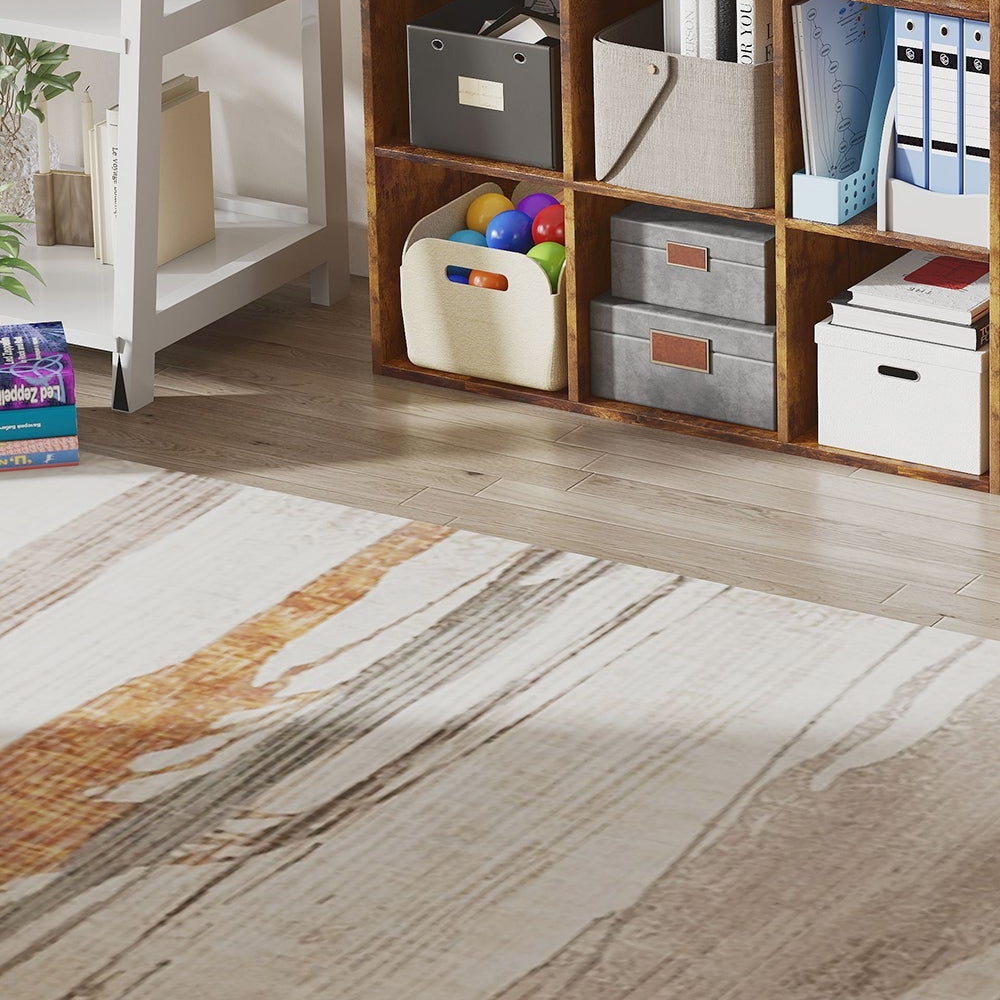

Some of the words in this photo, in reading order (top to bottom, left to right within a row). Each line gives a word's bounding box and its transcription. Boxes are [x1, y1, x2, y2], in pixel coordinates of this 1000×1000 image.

[740, 3, 753, 35] YOU
[0, 384, 38, 406] Zeppeli
[40, 384, 61, 402] Led
